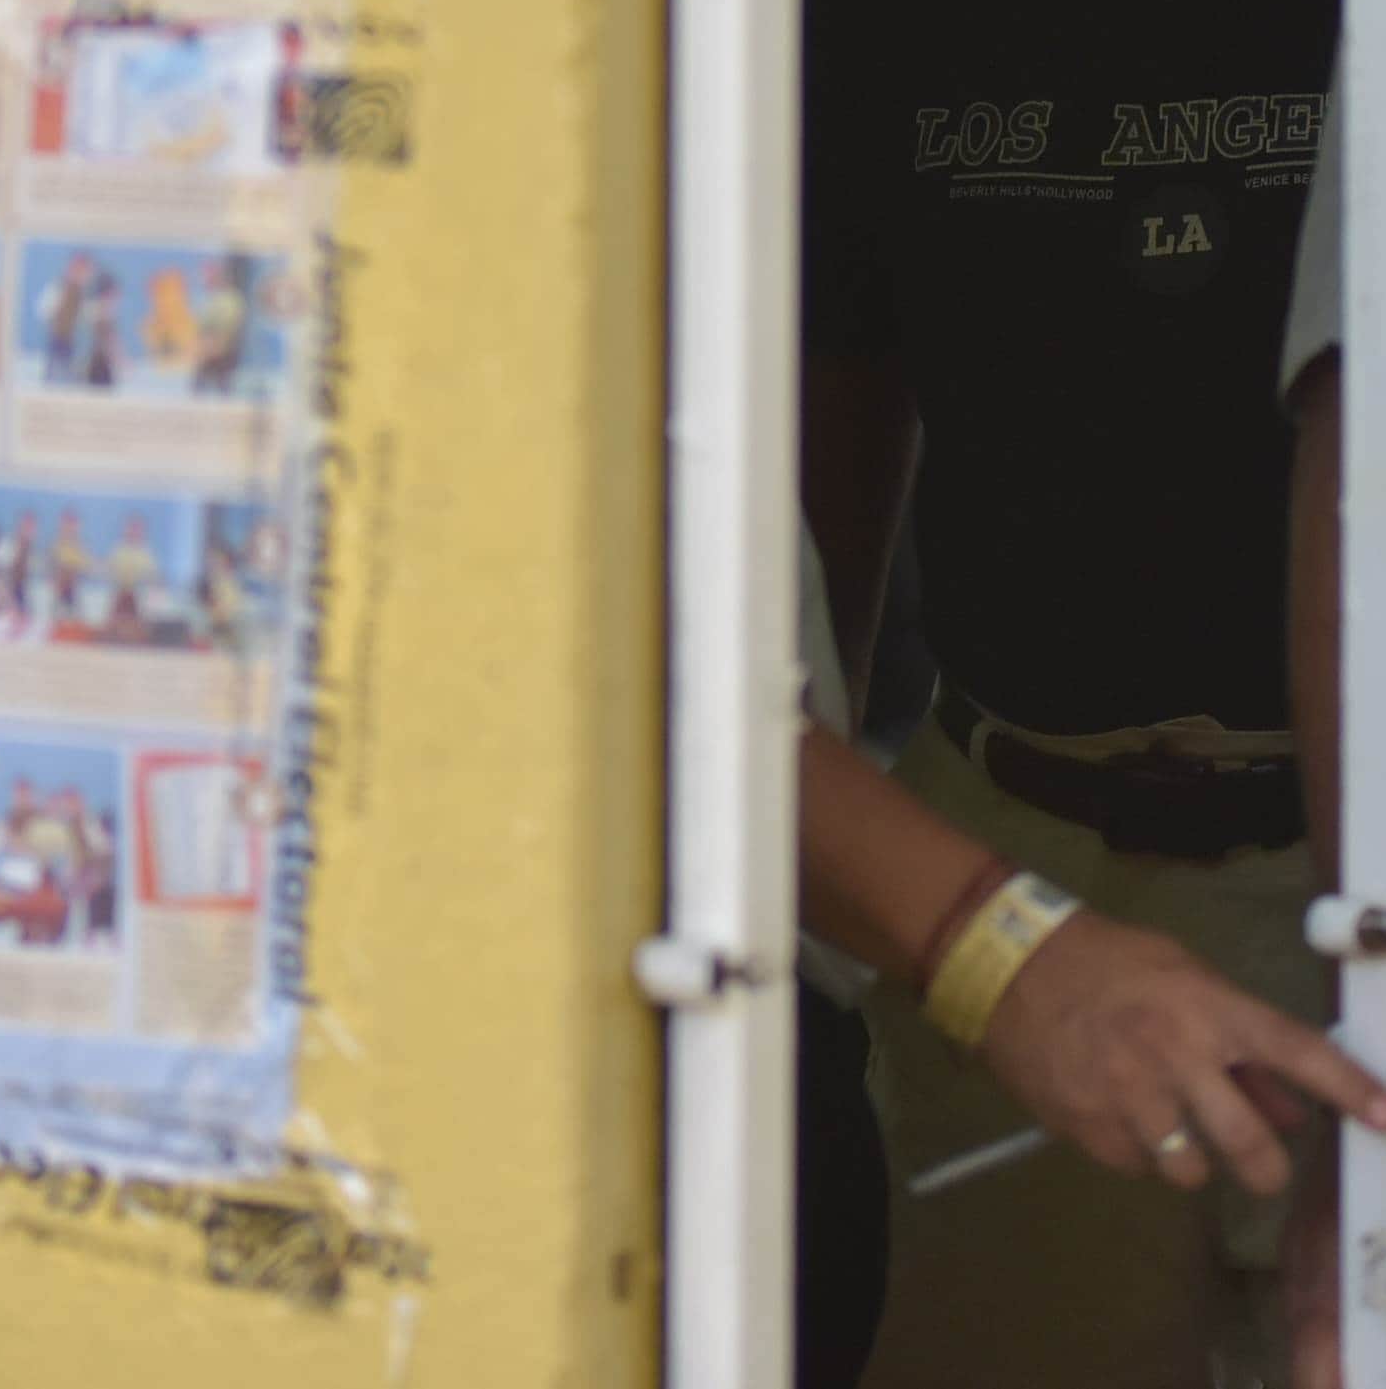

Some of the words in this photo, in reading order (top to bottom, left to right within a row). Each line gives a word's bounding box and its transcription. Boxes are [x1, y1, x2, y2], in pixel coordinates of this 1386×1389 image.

[915, 100, 1053, 172] LOS
[1102, 92, 1331, 165] ANGE
[949, 186, 997, 199] BEVERLY
[1244, 173, 1289, 189] VENICE
[1293, 172, 1315, 185] BE
[1142, 214, 1213, 257] LA
